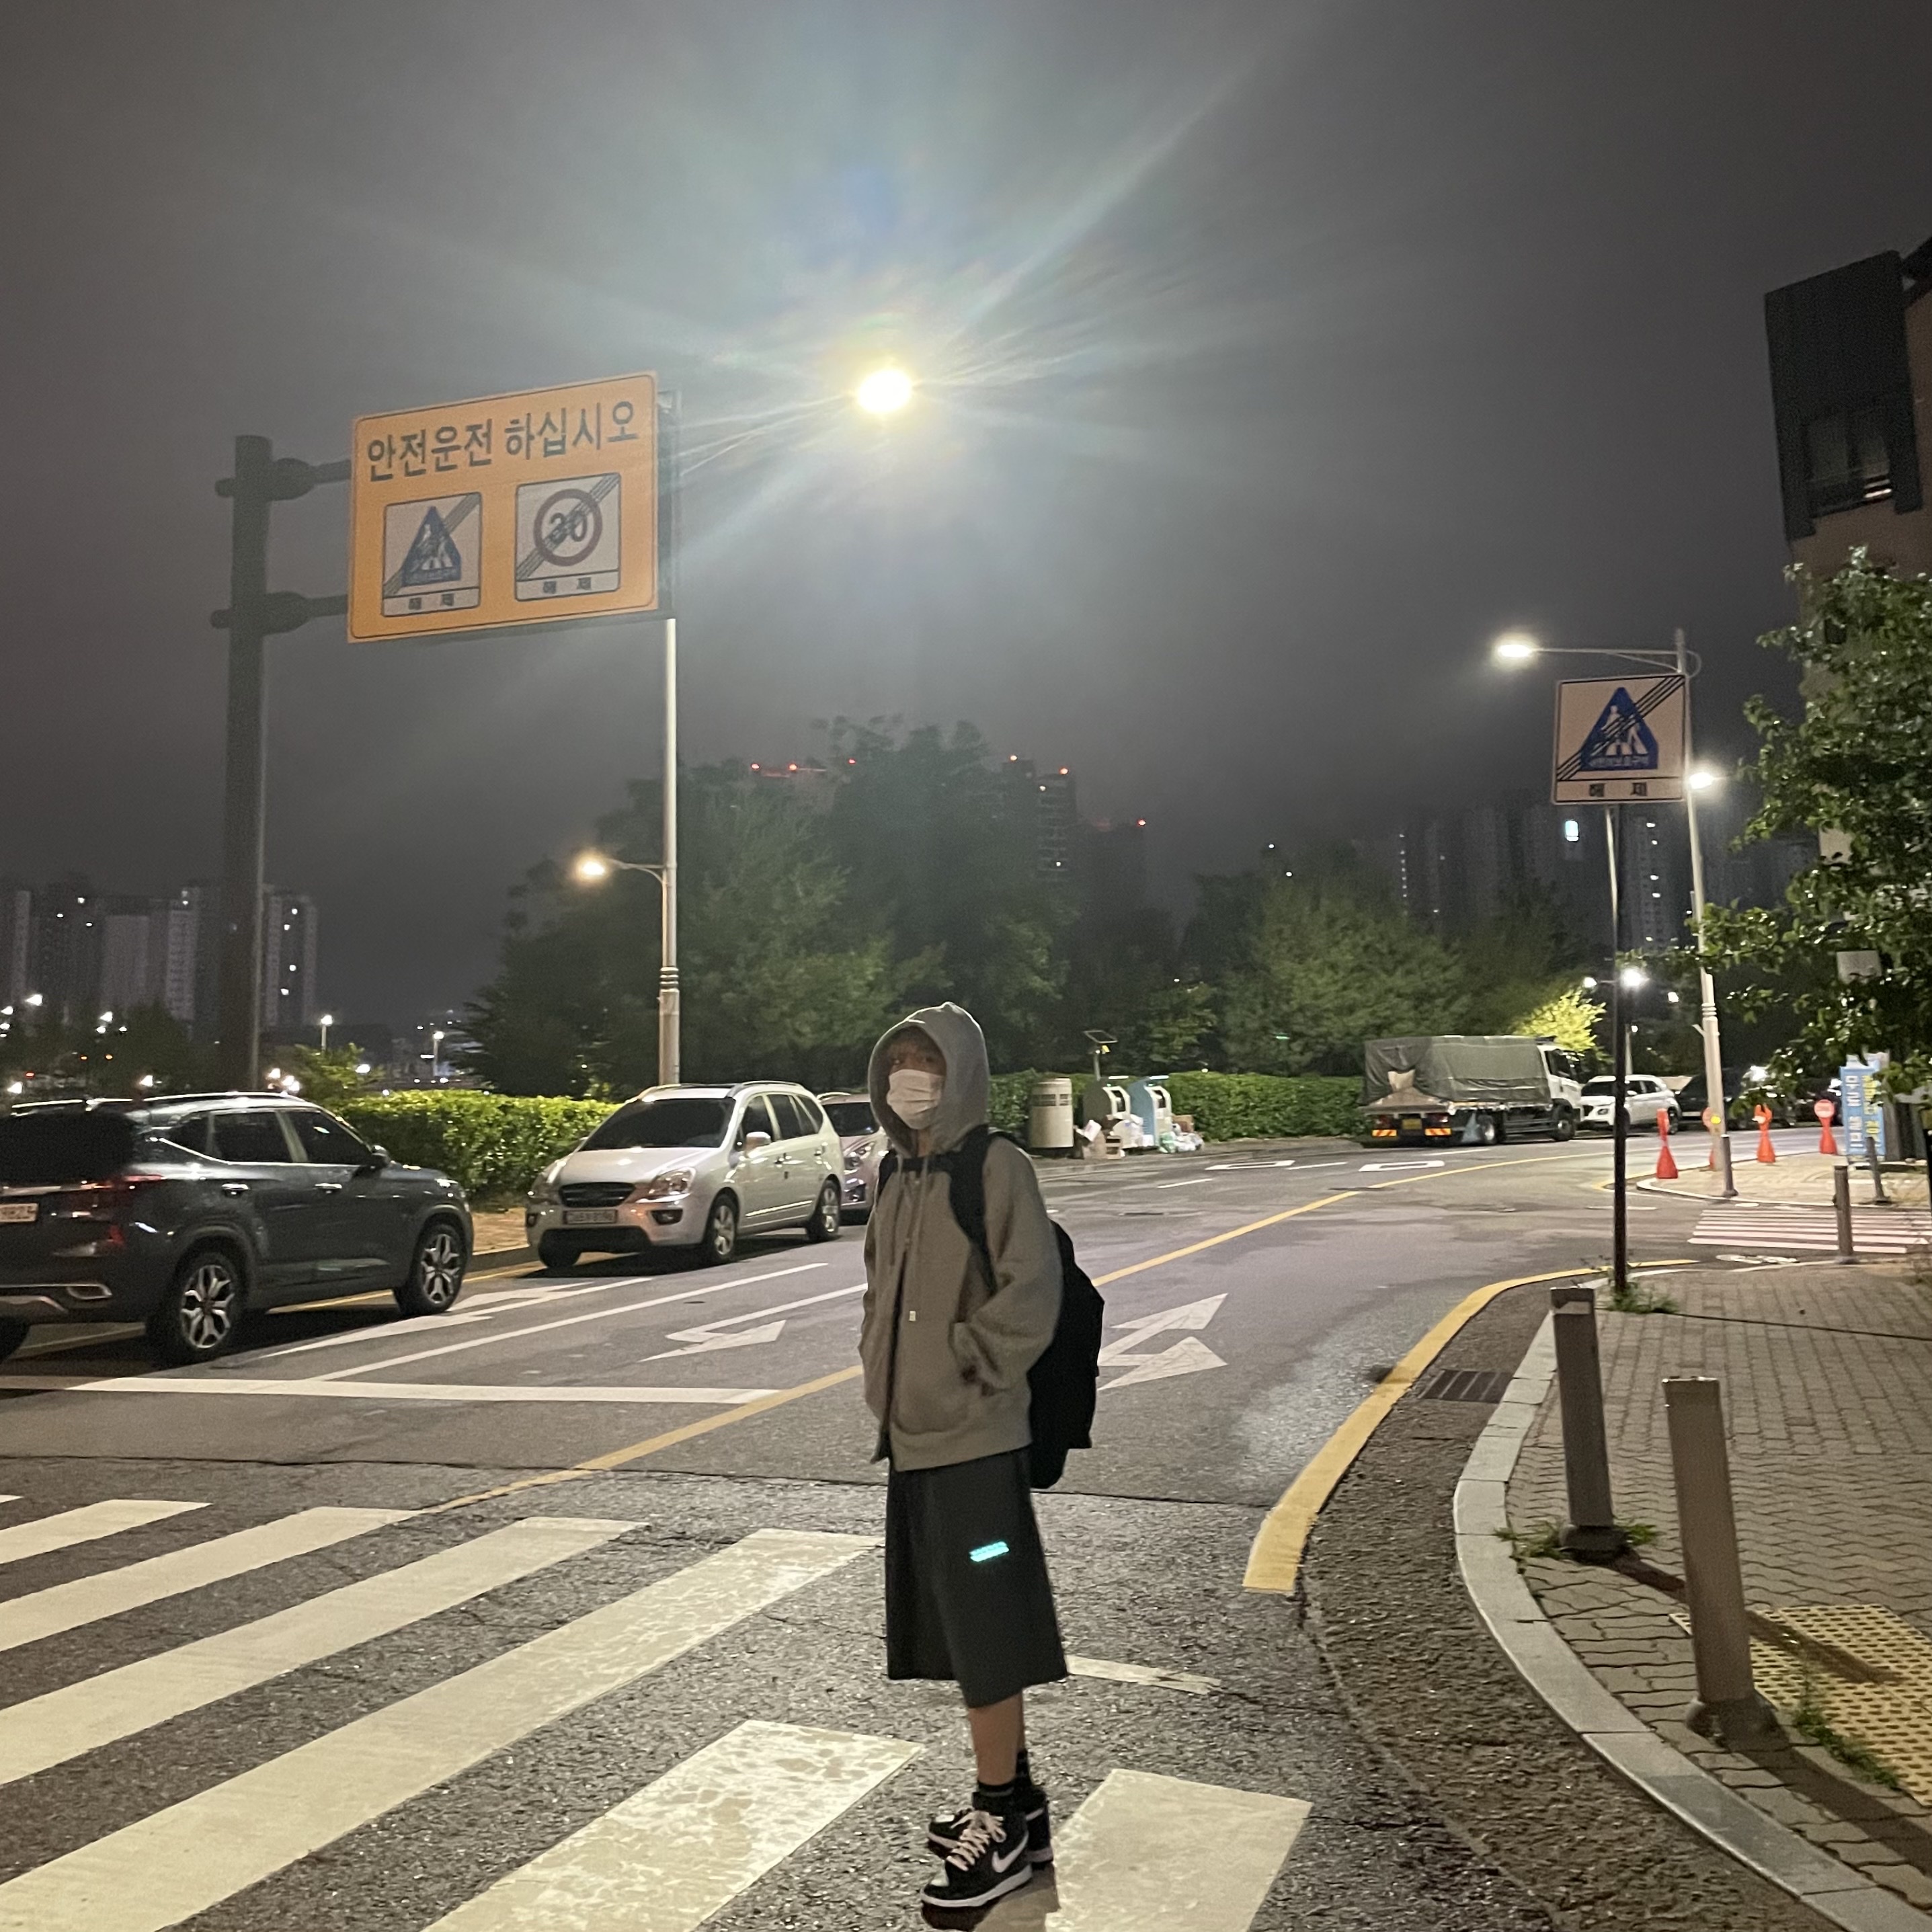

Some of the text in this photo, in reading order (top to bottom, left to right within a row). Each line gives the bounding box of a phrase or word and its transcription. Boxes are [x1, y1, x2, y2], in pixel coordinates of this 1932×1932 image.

[367, 401, 639, 482] 안전운전 하십시오
[549, 511, 588, 544] 30
